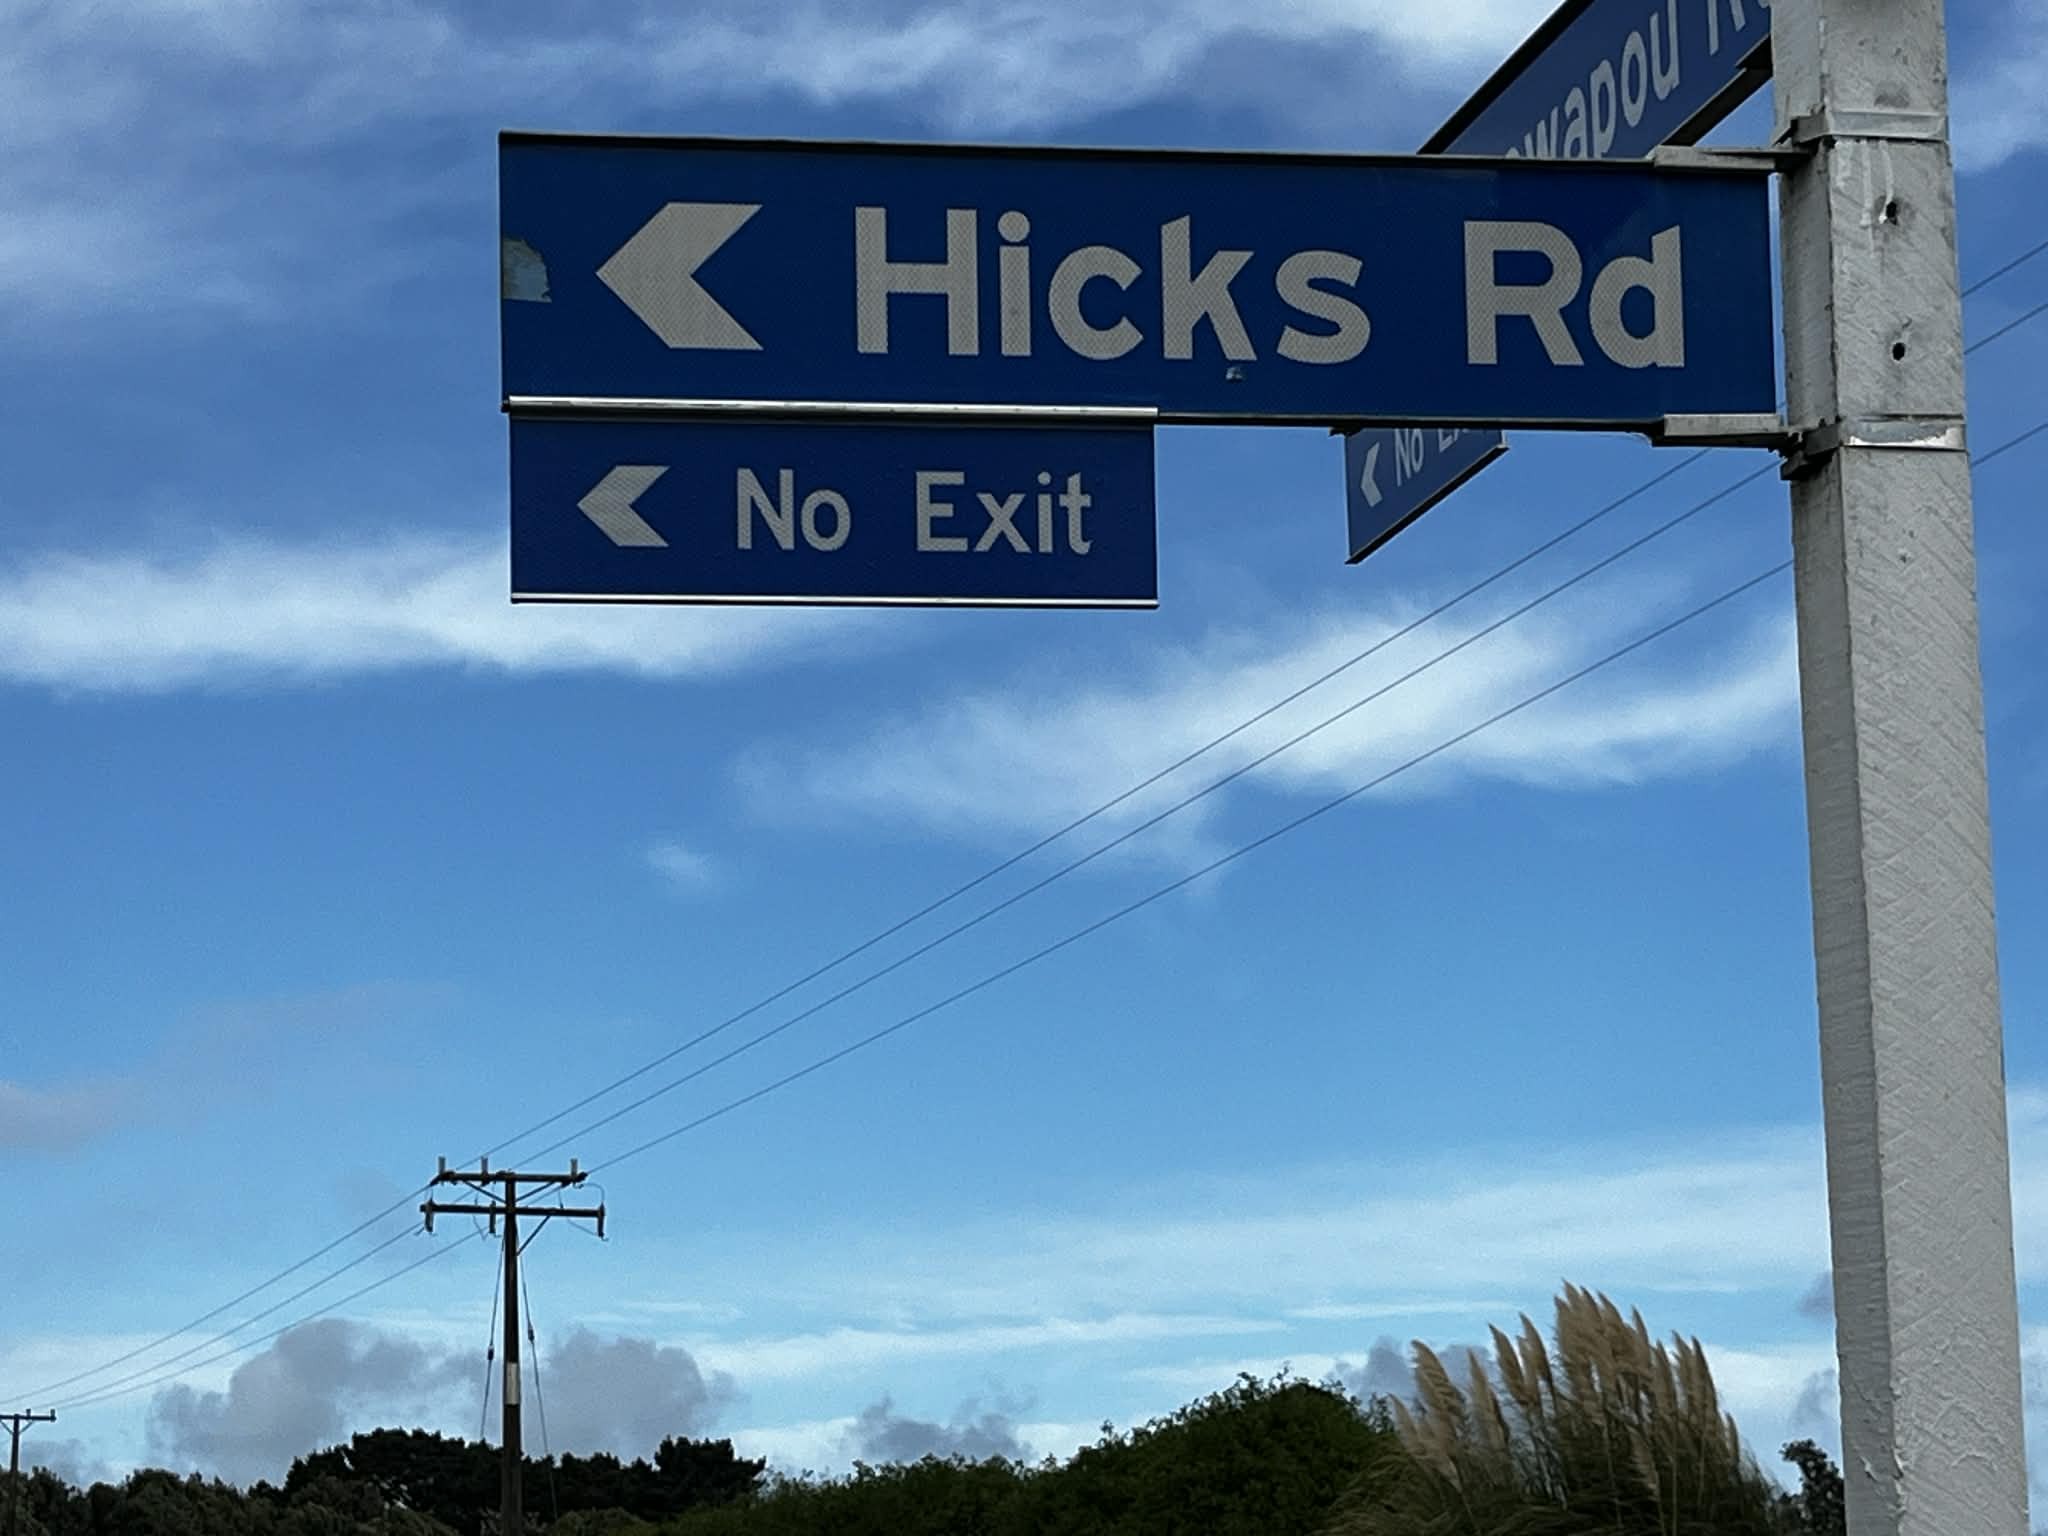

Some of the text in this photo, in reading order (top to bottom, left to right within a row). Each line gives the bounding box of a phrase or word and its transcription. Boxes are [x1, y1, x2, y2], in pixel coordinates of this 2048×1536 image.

[1505, 0, 1680, 160] wapou
[855, 206, 1685, 368] Hicks Rd
[736, 467, 1092, 554] No Exit
[1394, 429, 1424, 487] No
